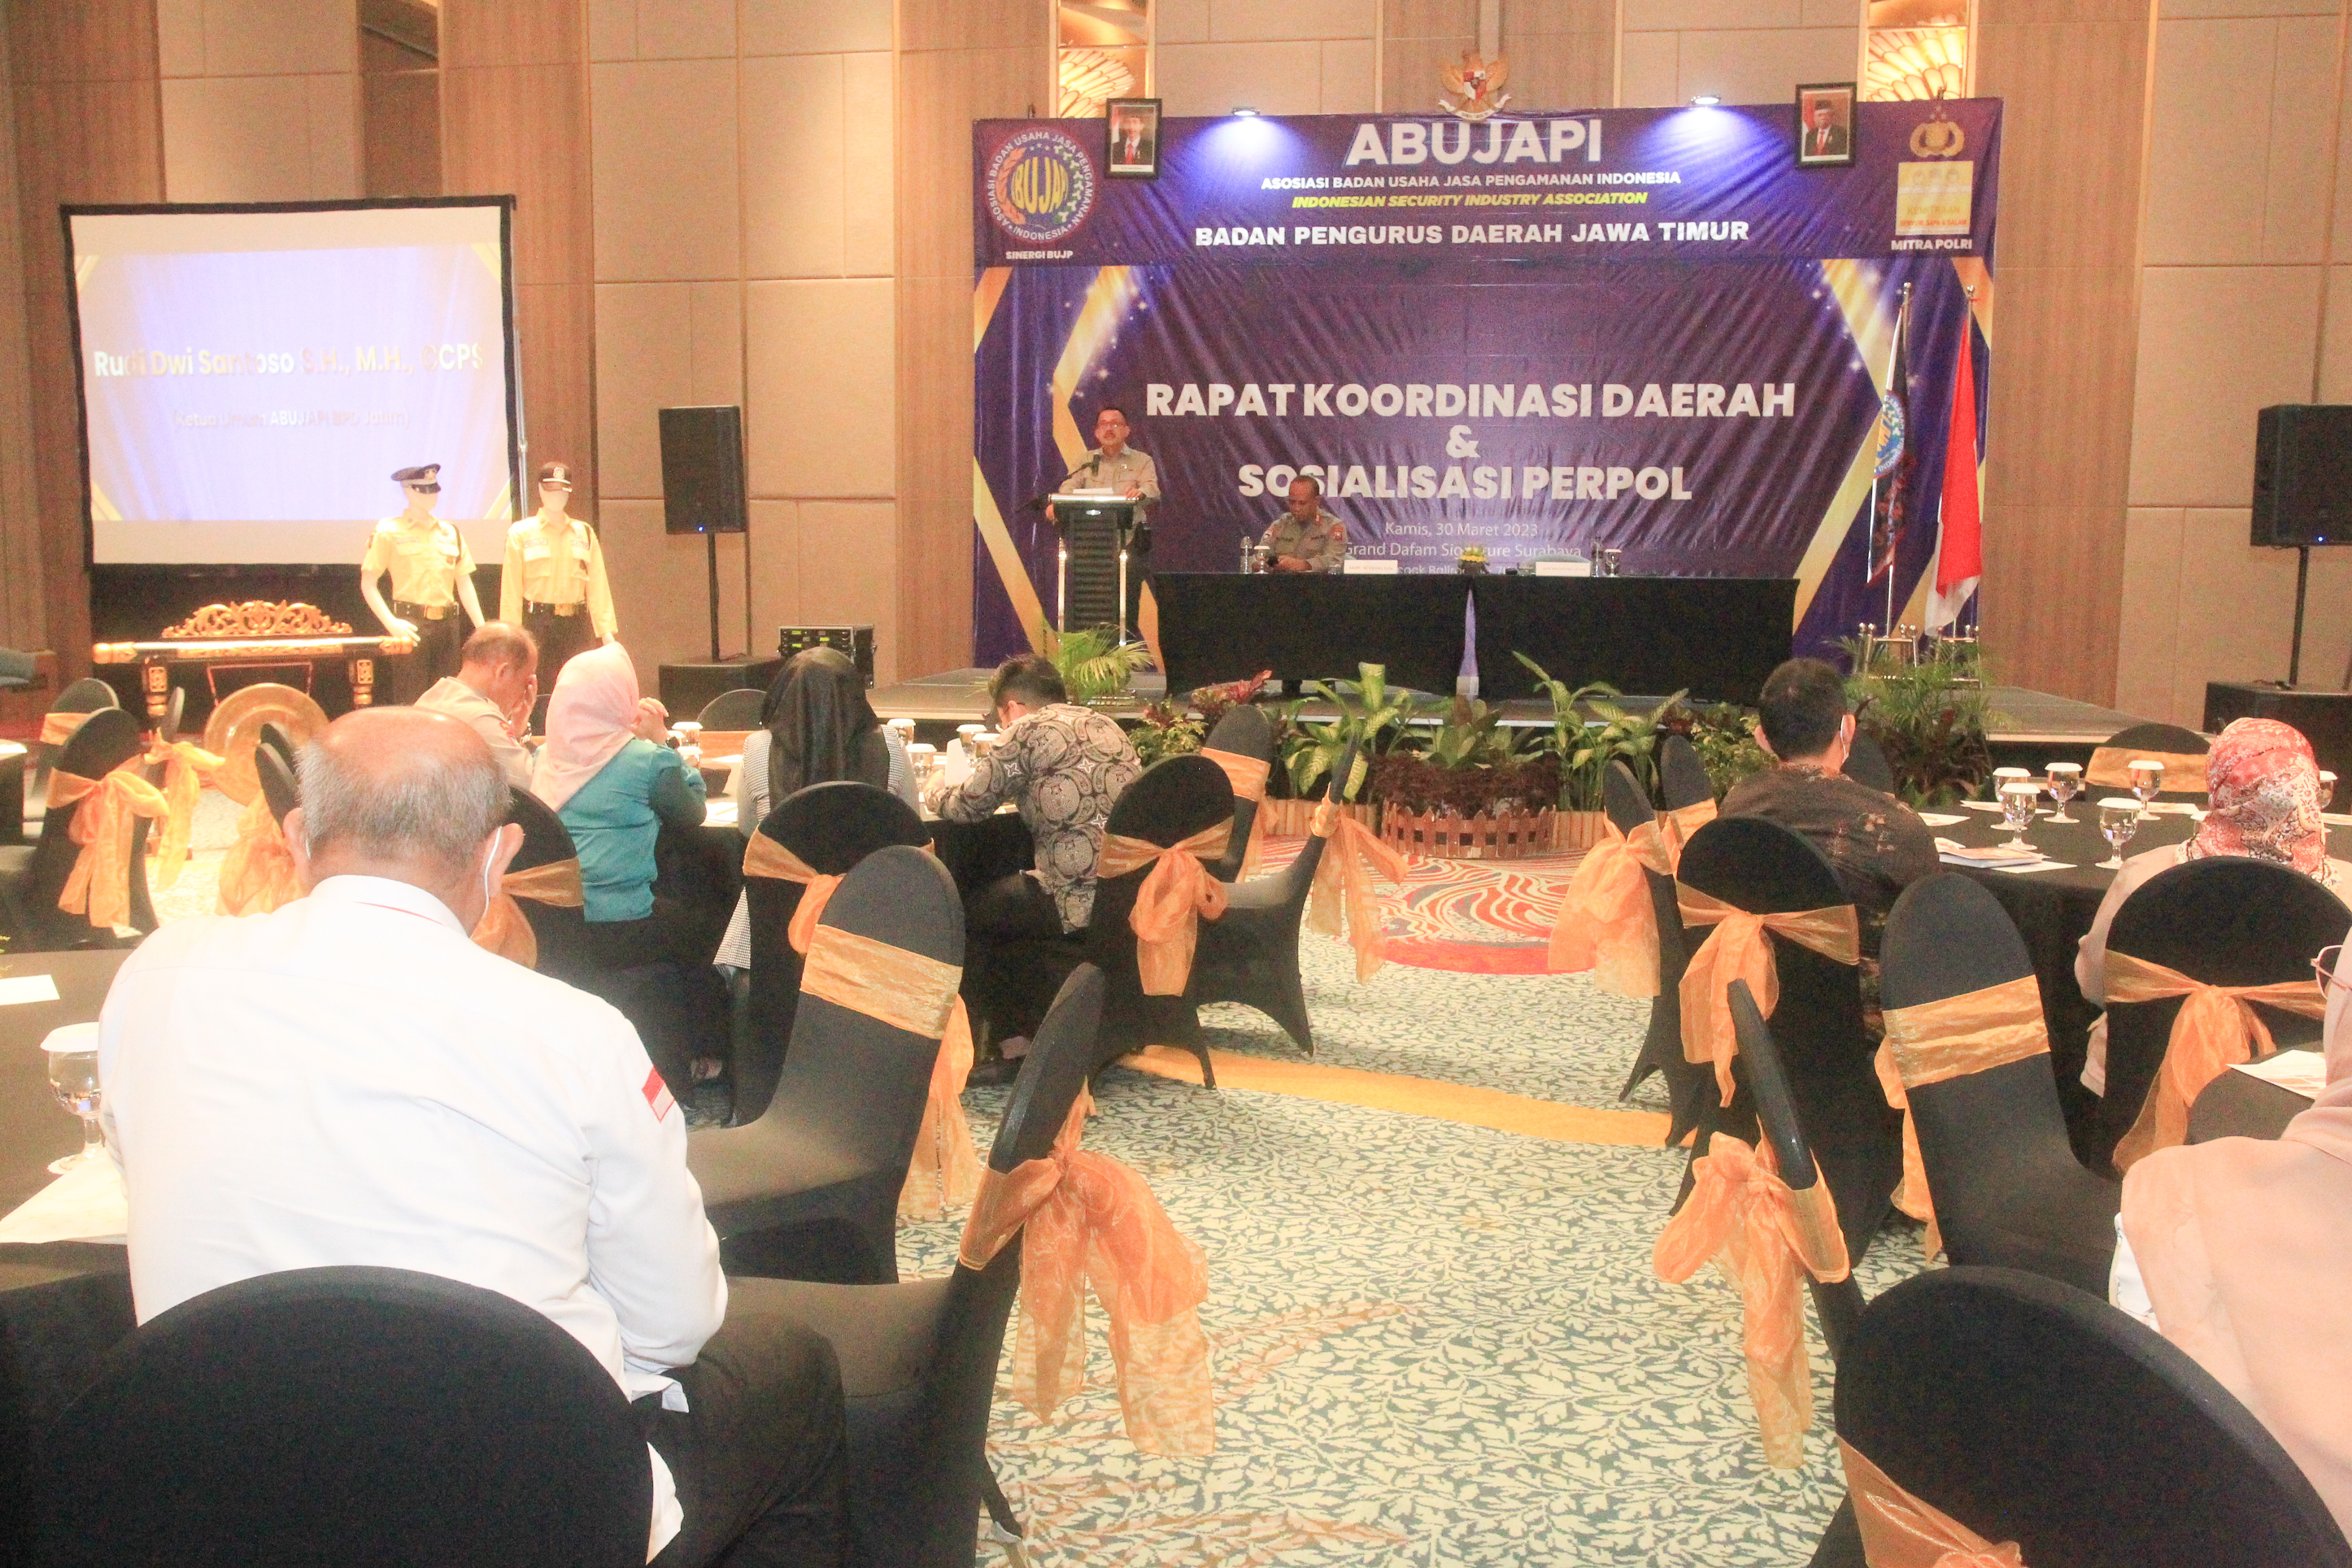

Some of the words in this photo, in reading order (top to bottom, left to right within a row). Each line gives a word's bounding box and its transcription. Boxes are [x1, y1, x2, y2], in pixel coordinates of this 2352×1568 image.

[1014, 132, 1050, 145] USAHA
[1052, 134, 1077, 153] JASA
[1345, 119, 1602, 165] ABUJAPI
[989, 143, 1014, 177] BADAN
[1071, 151, 1093, 225] PENGAMANAN
[1261, 177, 1329, 189] ASOSIASI
[1332, 176, 1385, 188] BADAN
[1388, 176, 1440, 188] USAHA
[1443, 175, 1481, 187] JASA
[1485, 173, 1593, 186] PENGAMANAN
[1597, 171, 1682, 185] INDONESIA
[988, 179, 1010, 226] ASOSIASI
[1292, 196, 1386, 208] INDONESIAN
[1388, 195, 1463, 207] SECURITY
[1464, 194, 1542, 206] INDUSTRY
[1542, 192, 1649, 205] ASSOCIATION
[1013, 226, 1069, 240] INDONESIA
[1196, 227, 1285, 246] BADAN
[1294, 225, 1443, 246] PENGURUS
[1451, 224, 1563, 243] DAERAH
[1571, 223, 1650, 242] JAWA
[1658, 221, 1749, 241] TIMUR
[1006, 251, 1045, 260] SINERGI
[1046, 250, 1074, 259] BUJP
[1891, 240, 1932, 250] MITRA
[1935, 239, 1972, 249] POLRI
[94, 349, 148, 376] Rudi
[152, 347, 194, 376] Dwi
[199, 348, 295, 376] Santoso
[302, 347, 350, 376] S.H.,
[357, 346, 415, 375] M.H.,
[420, 342, 486, 372] CCPS
[1146, 383, 1295, 416] RAPAT
[1304, 383, 1592, 418] KOORDINASI
[1602, 383, 1796, 418] DAERAH
[1445, 424, 1481, 458] &
[1238, 464, 1512, 499] SOSIALISASI
[1523, 466, 1693, 500] PERPOL
[1386, 522, 1432, 537] Kamis,
[1436, 523, 1453, 536] 30
[1457, 523, 1499, 536] Maret
[1503, 523, 1539, 537] 2023
[1390, 542, 1437, 556] Dafam
[1441, 543, 1511, 560] Sigture
